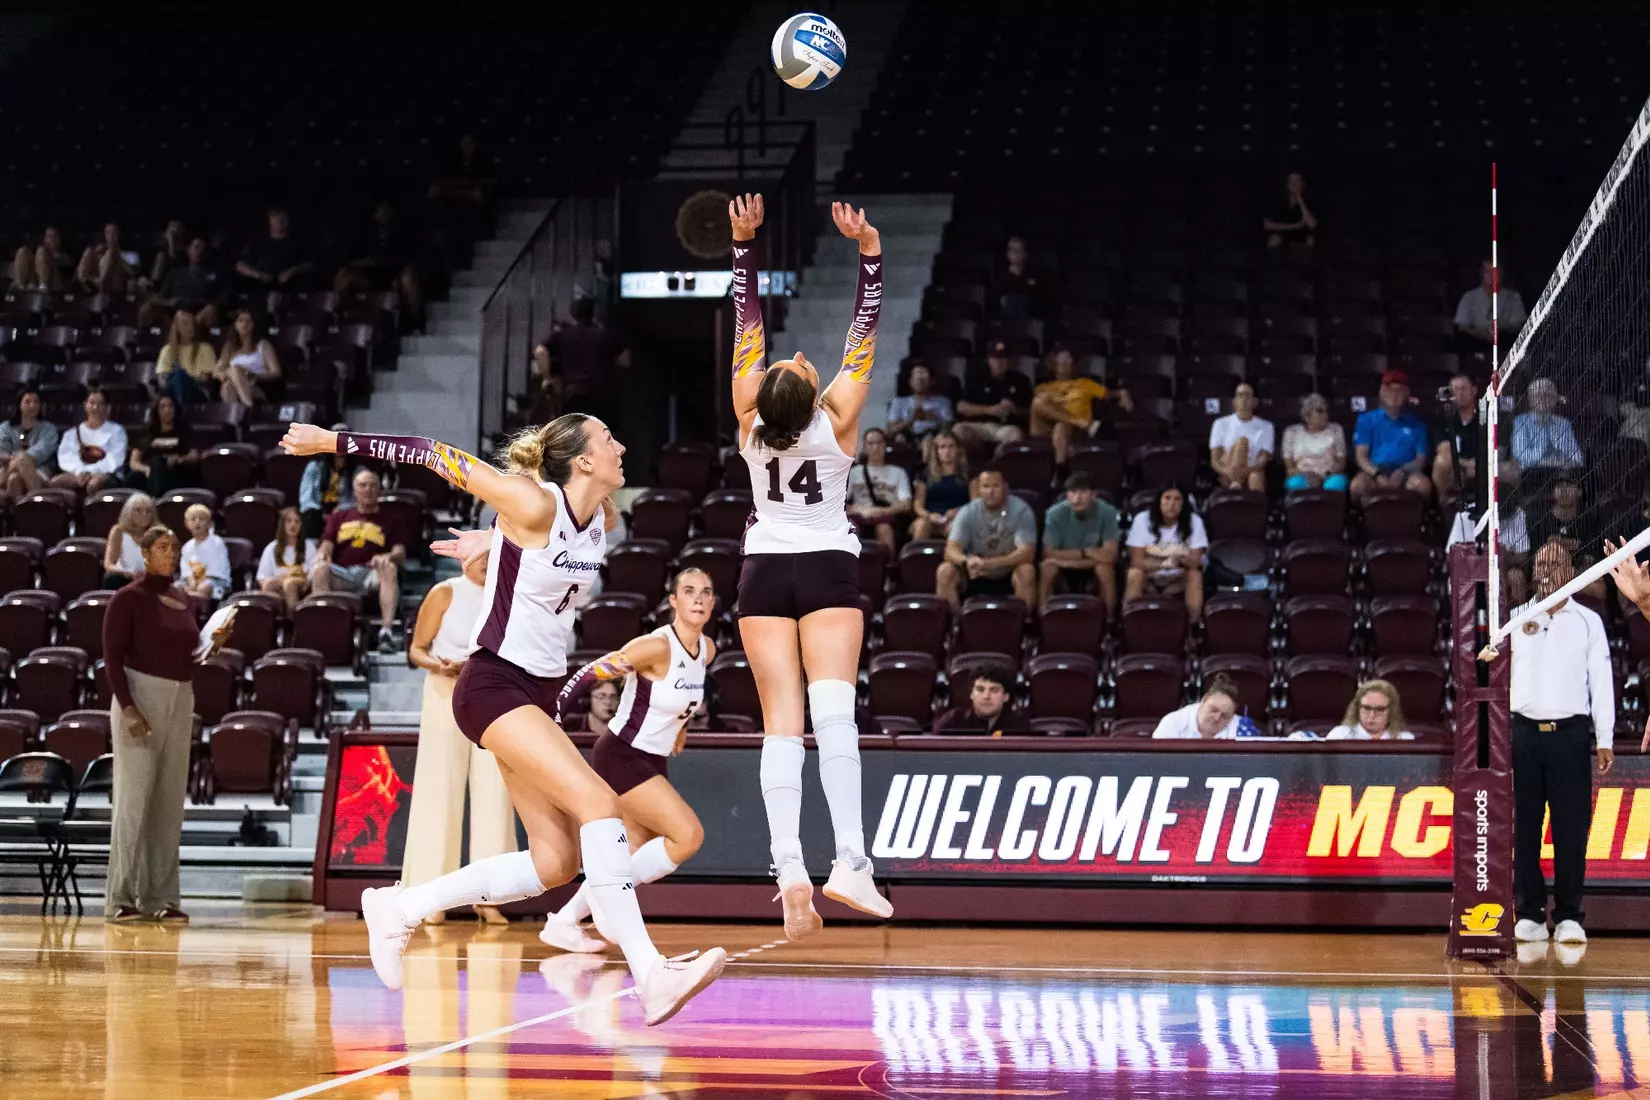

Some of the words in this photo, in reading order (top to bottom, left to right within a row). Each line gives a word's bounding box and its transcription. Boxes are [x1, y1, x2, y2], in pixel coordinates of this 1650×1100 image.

[811, 24, 845, 49] molten
[847, 282, 882, 349] CHIPPEWAS
[765, 457, 824, 505] 14
[554, 584, 579, 615] 6
[678, 701, 698, 720] 5
[870, 774, 1189, 862] WELCOME
[1194, 776, 1280, 862] TO
[1474, 790, 1488, 835] sports
[1474, 836, 1488, 891] imports
